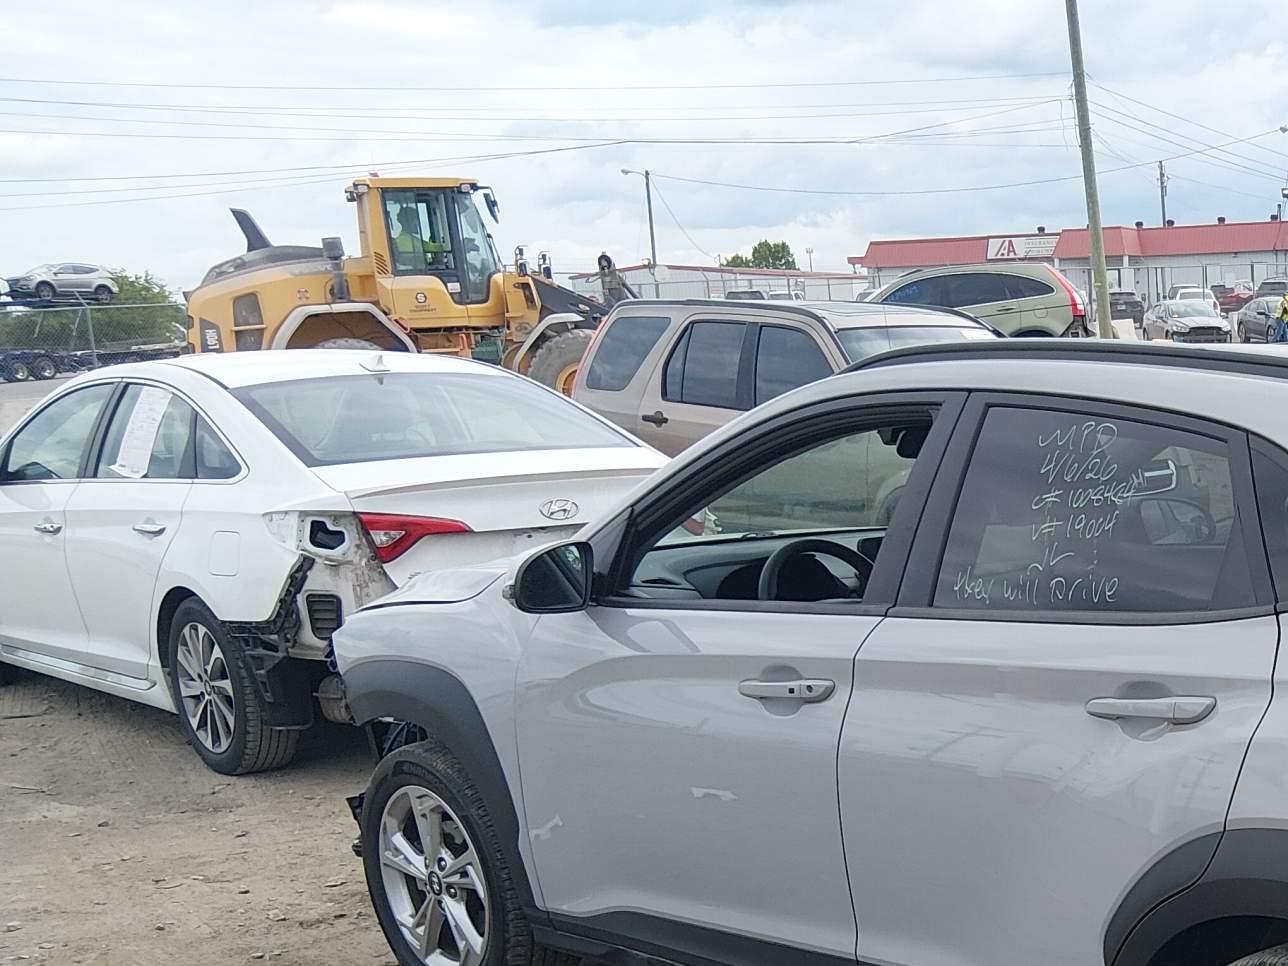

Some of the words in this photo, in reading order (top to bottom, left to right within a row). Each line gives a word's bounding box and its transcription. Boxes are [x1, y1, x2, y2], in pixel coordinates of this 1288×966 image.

[205, 329, 220, 349] L90H
[1039, 421, 1117, 453] MPD
[1040, 450, 1117, 484] 4/6/26
[1004, 575, 1038, 604] will
